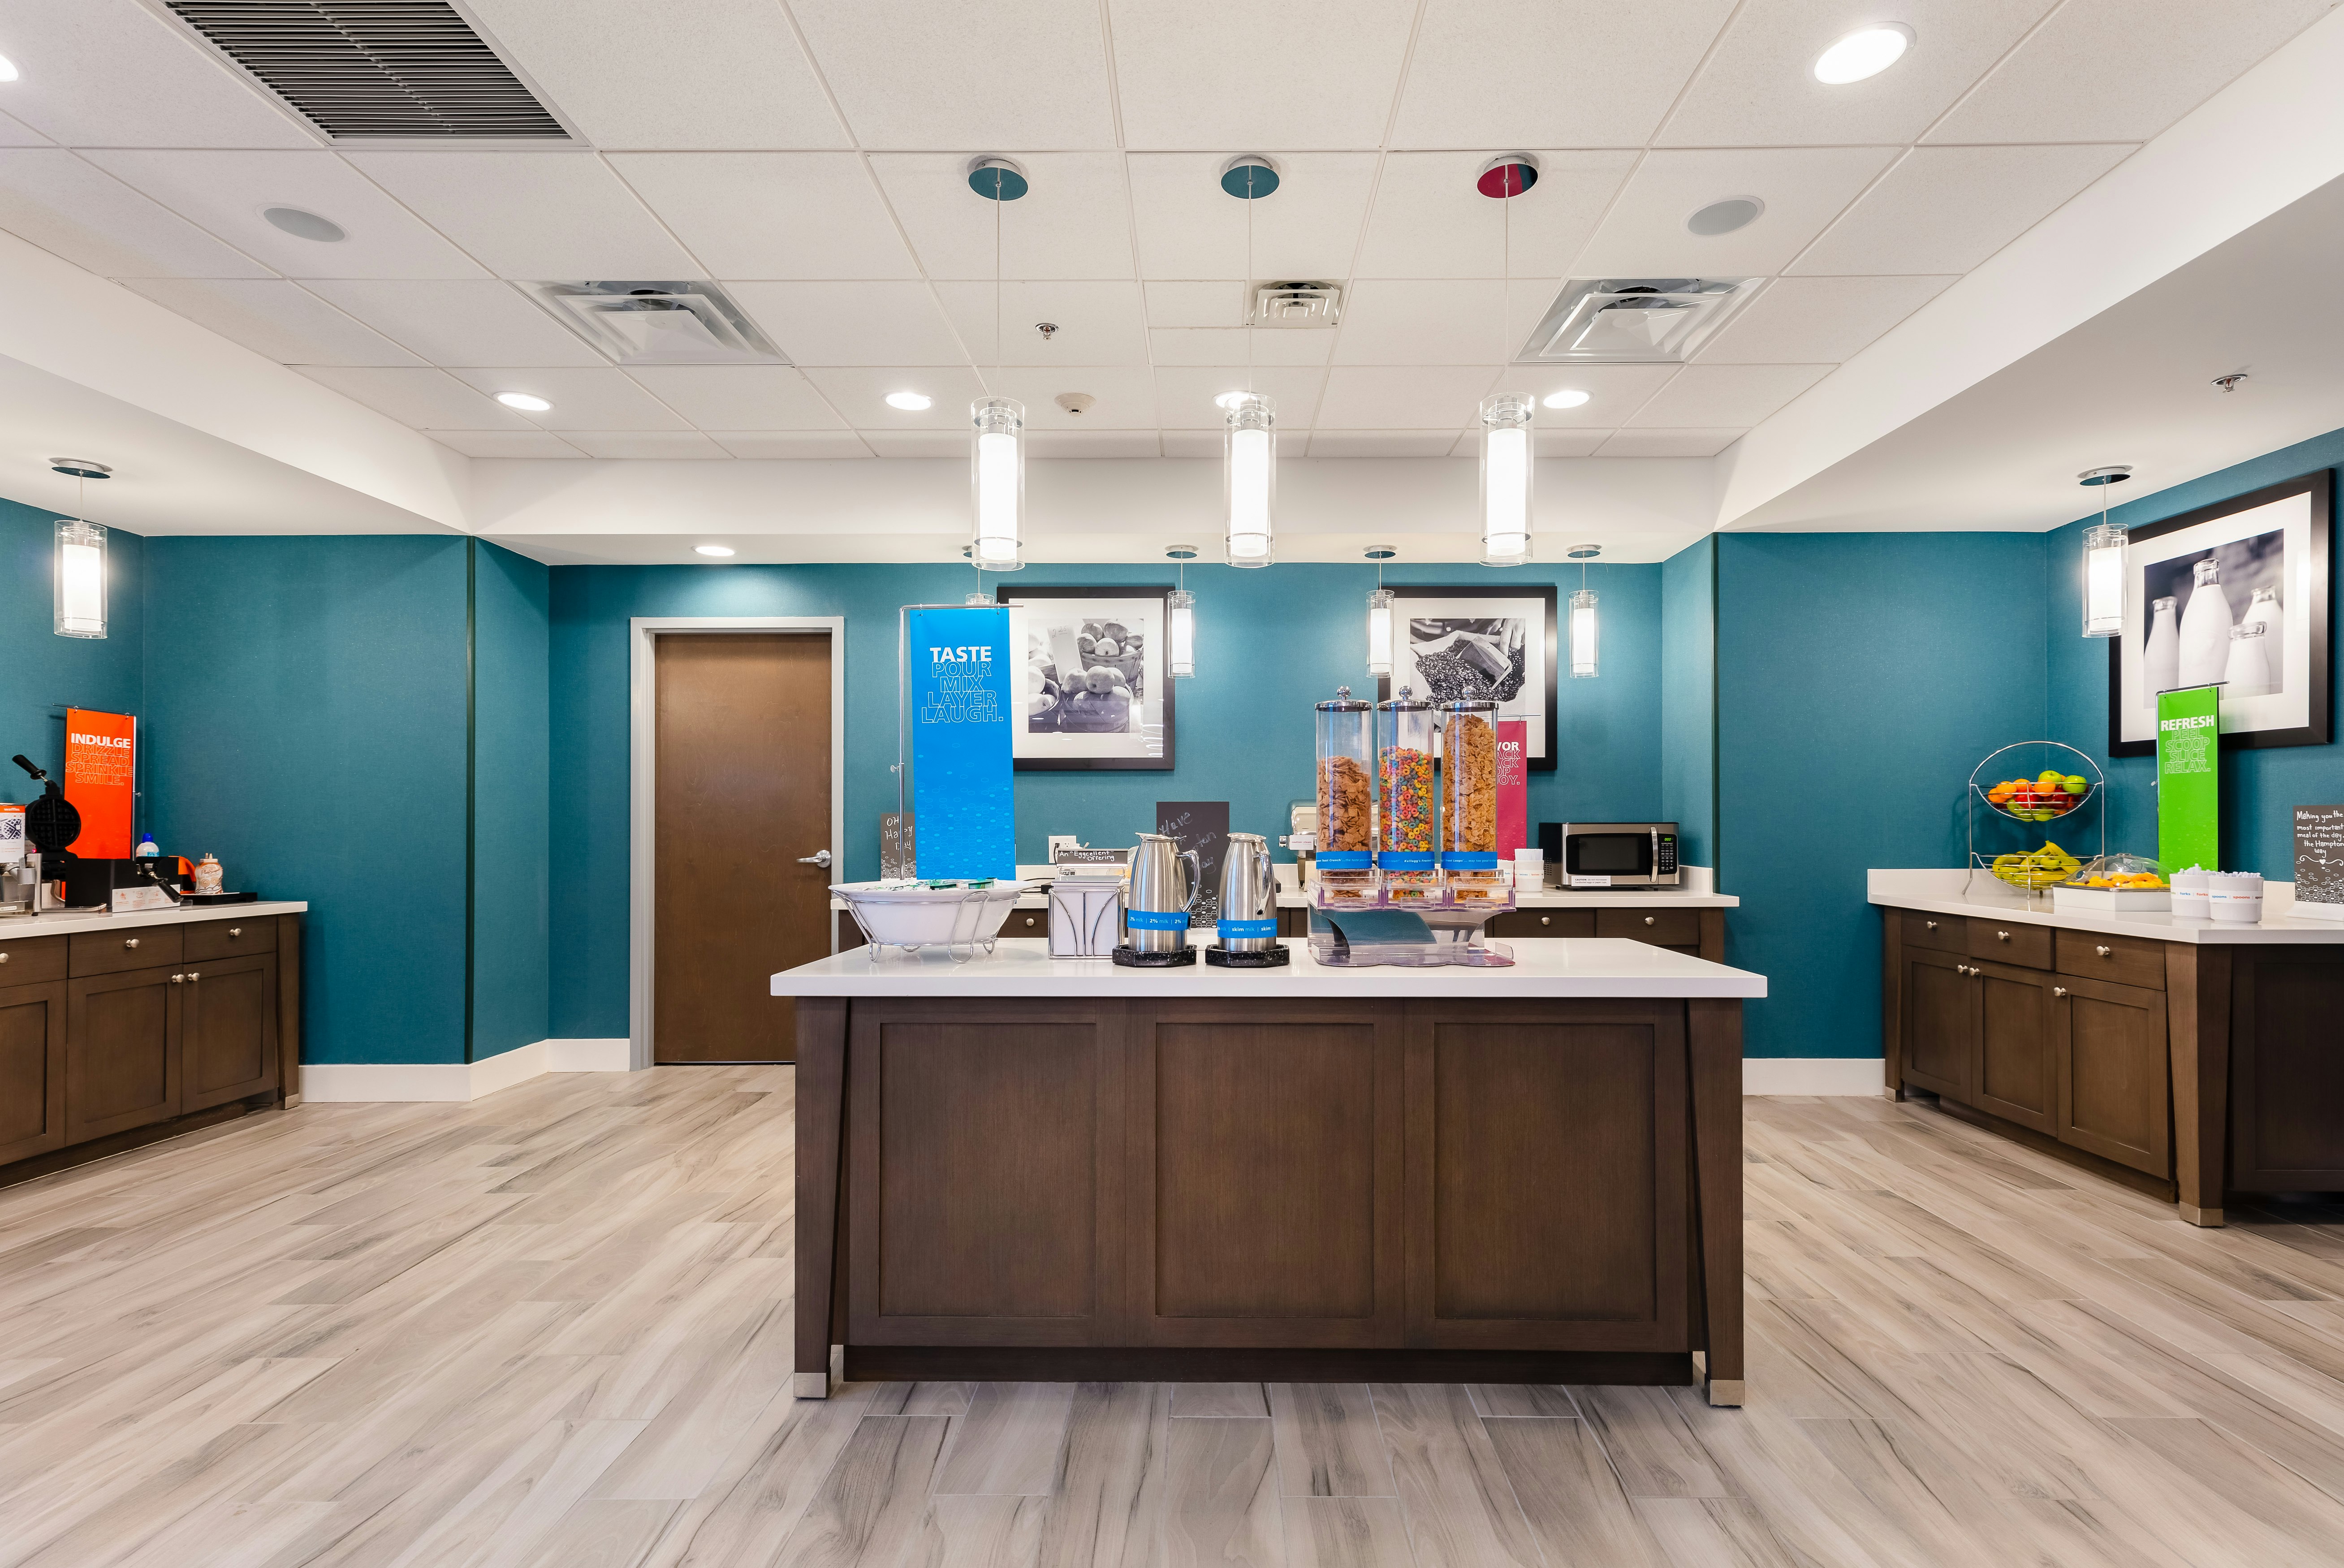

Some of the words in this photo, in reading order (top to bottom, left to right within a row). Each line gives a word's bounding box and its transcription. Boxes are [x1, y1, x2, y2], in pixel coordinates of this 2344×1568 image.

[929, 646, 992, 663] TASTE
[932, 661, 992, 677] POUR
[940, 676, 984, 692] MIX
[928, 690, 997, 708] LAYER
[921, 706, 1004, 724] LAUGH.
[2161, 715, 2214, 731] REFRESH
[71, 733, 131, 748] INDULGE
[2172, 727, 2203, 741] PEEL
[72, 743, 129, 758] DRIZZLE
[2165, 737, 2210, 752] SCOOP
[71, 752, 129, 767] SPREAD
[1497, 750, 1520, 759] ACK
[2170, 749, 2206, 762] SLICE
[65, 762, 133, 777] SPRINKLE
[1497, 767, 1511, 776] OP
[2165, 760, 2211, 774] RELAX.
[75, 772, 124, 785] SMILE.
[1159, 812, 1192, 835] Have
[2297, 810, 2319, 823] Making
[2321, 814, 2332, 823] you
[2315, 823, 2344, 832] important
[2315, 840, 2344, 849] Hampton
[2314, 848, 2326, 858] way
